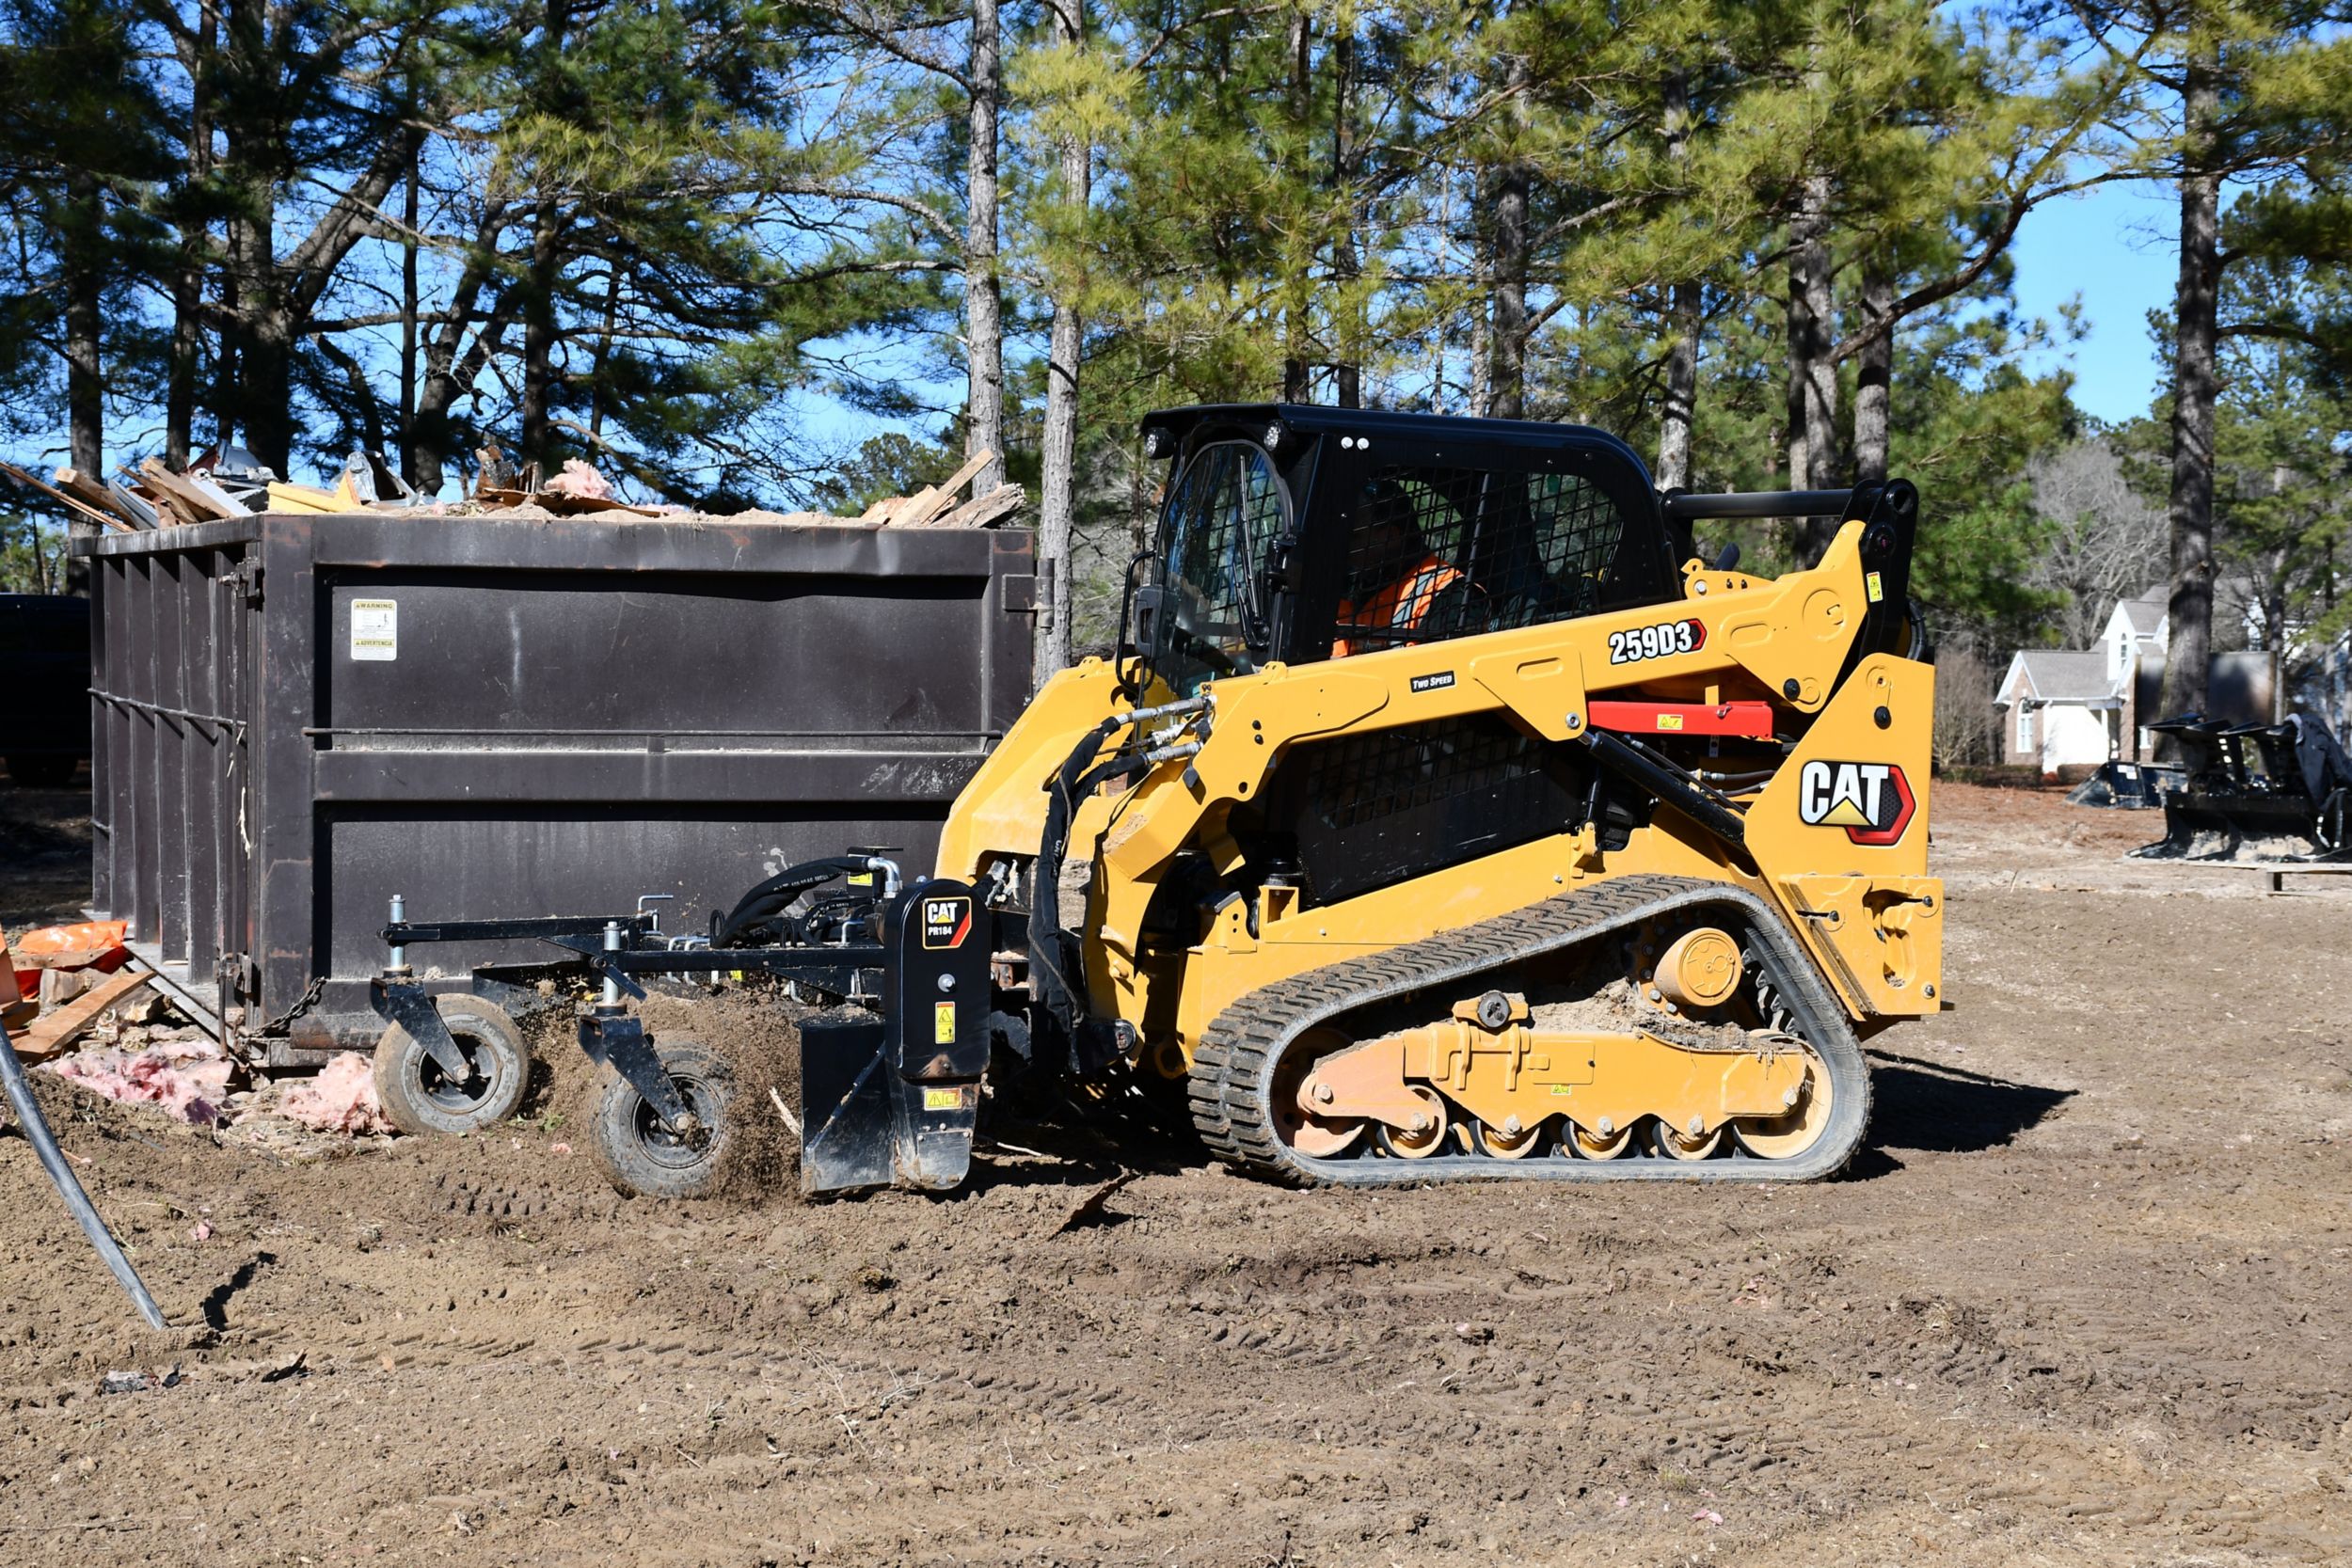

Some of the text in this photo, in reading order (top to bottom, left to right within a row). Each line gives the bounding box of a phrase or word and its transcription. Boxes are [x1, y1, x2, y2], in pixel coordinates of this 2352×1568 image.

[1609, 620, 1693, 664] 259D3
[1801, 761, 1889, 827] CAT
[928, 902, 958, 924] CAT
[928, 926, 952, 936] PR184
